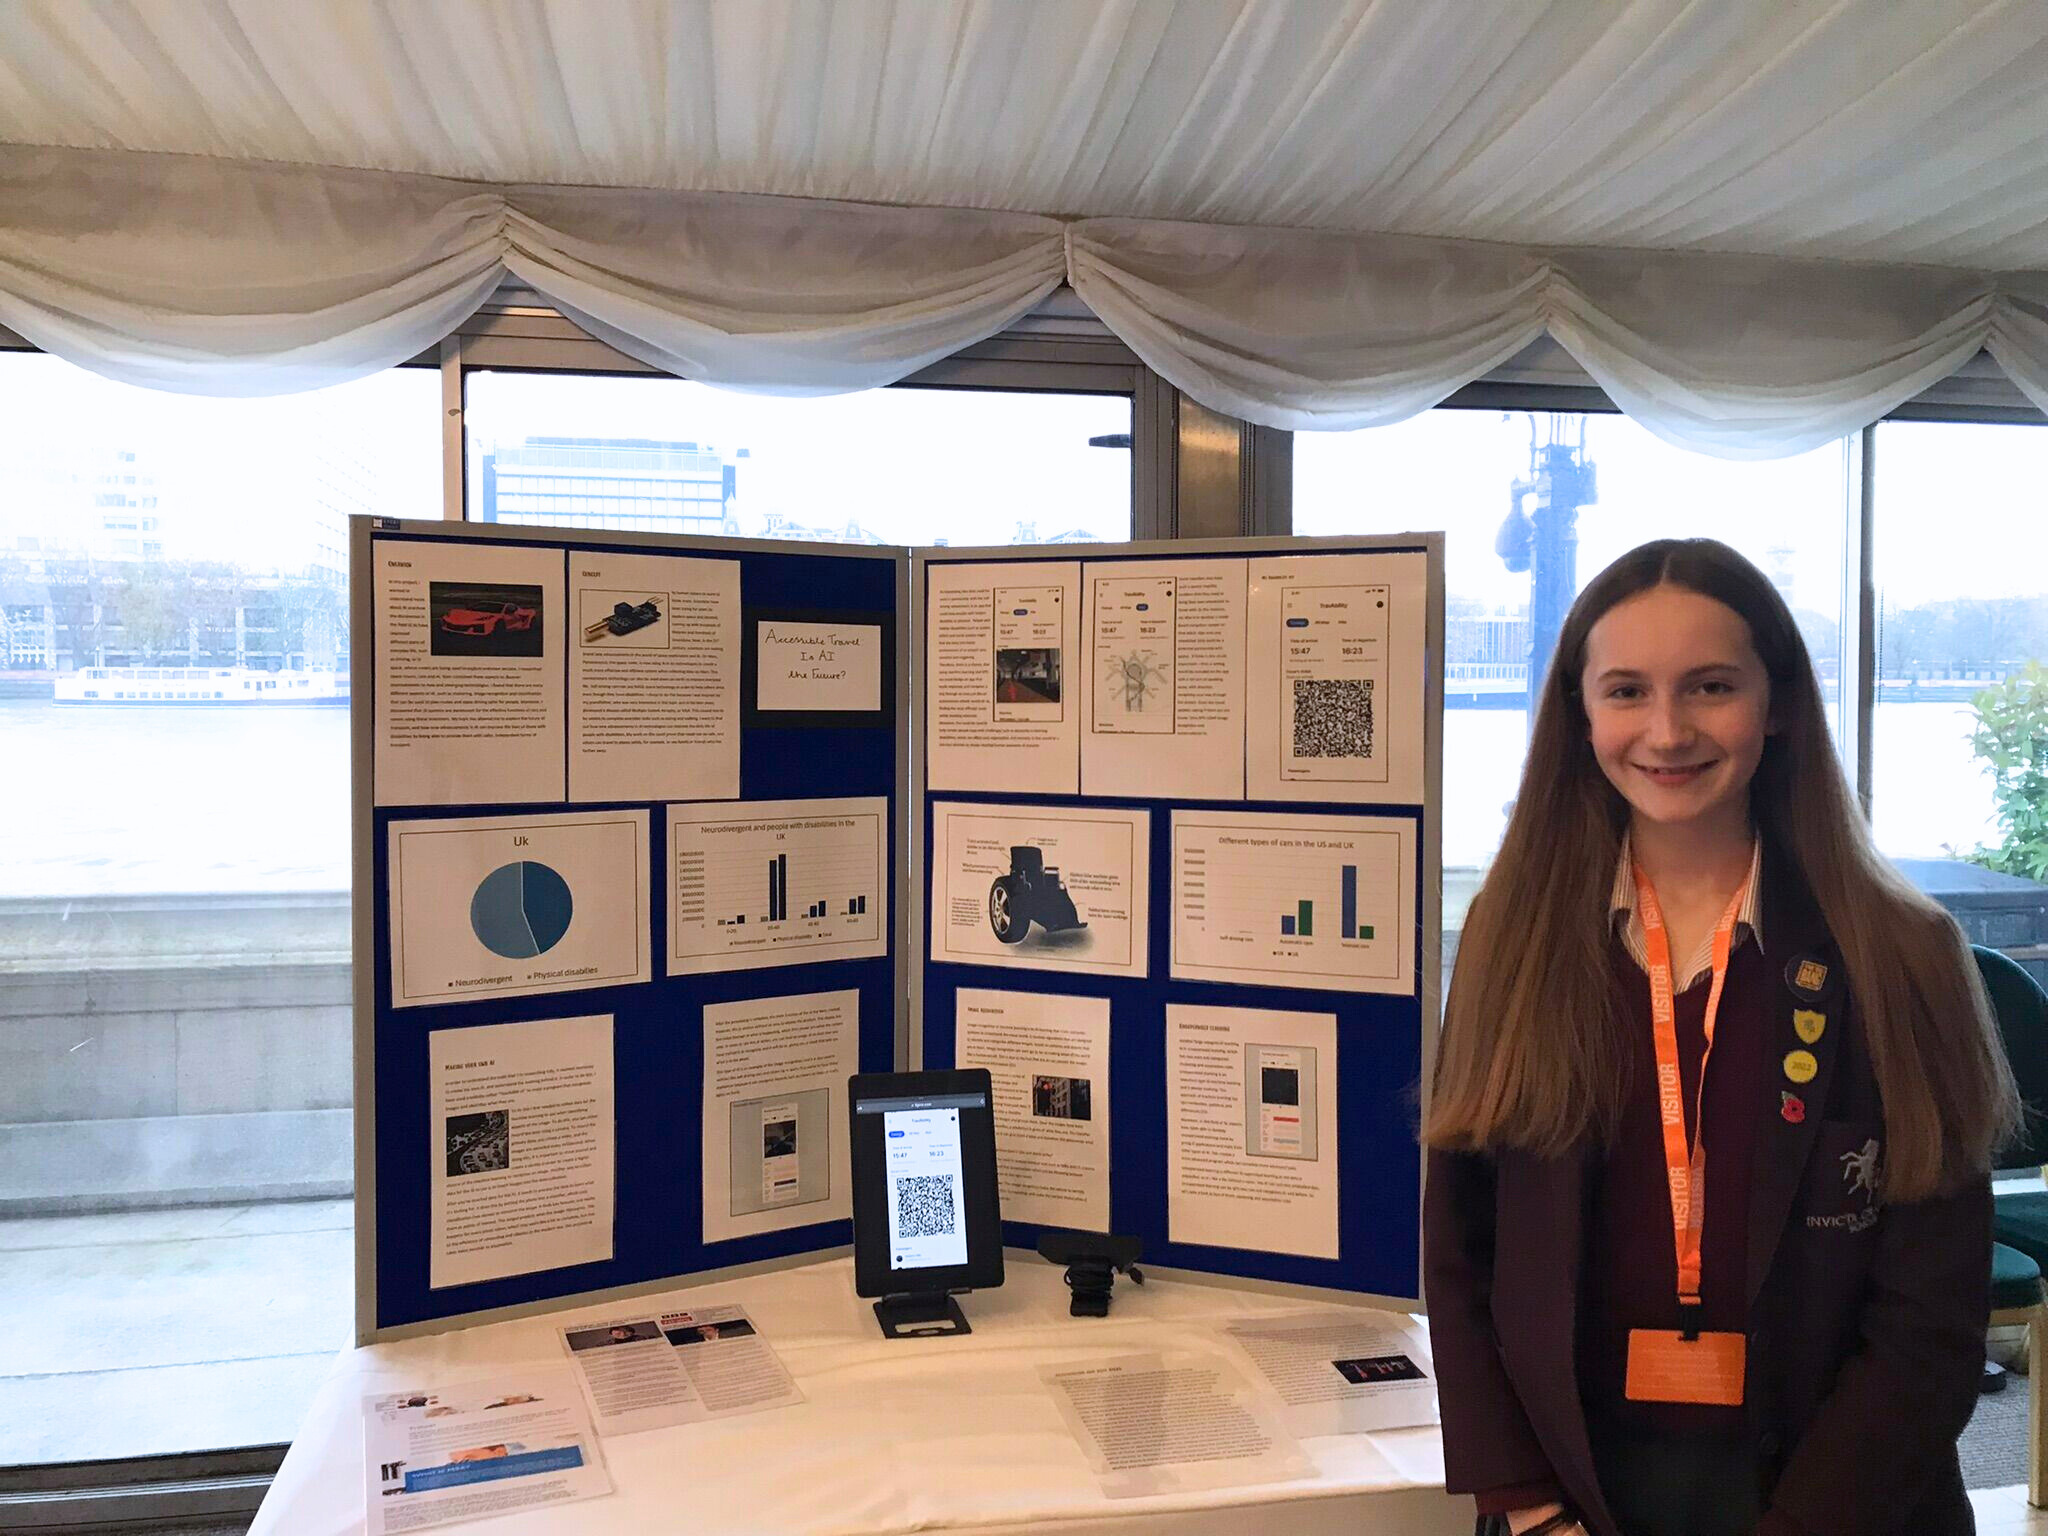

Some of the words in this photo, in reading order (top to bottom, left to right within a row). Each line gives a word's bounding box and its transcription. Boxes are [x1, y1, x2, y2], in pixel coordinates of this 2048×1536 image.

[765, 628, 825, 646] Accessible
[828, 633, 861, 646] Travel
[818, 650, 835, 661] AI
[788, 671, 807, 679] the
[811, 668, 846, 680] Future?
[701, 825, 752, 835] Neurodivergent
[754, 824, 766, 832] and
[767, 823, 789, 832] people
[790, 822, 803, 830] with
[845, 819, 856, 827] the
[776, 832, 786, 841] UK
[1219, 837, 1249, 846] Different
[1250, 839, 1269, 848] types
[1270, 838, 1279, 847] of
[1303, 840, 1315, 848] the
[1328, 841, 1341, 849] and
[533, 969, 563, 980] Physical
[455, 975, 513, 987] Neurodivergent
[1650, 964, 1671, 1023] VISITOR
[1659, 1062, 1681, 1126] VISITOR
[1669, 1165, 1689, 1230] VISITOR
